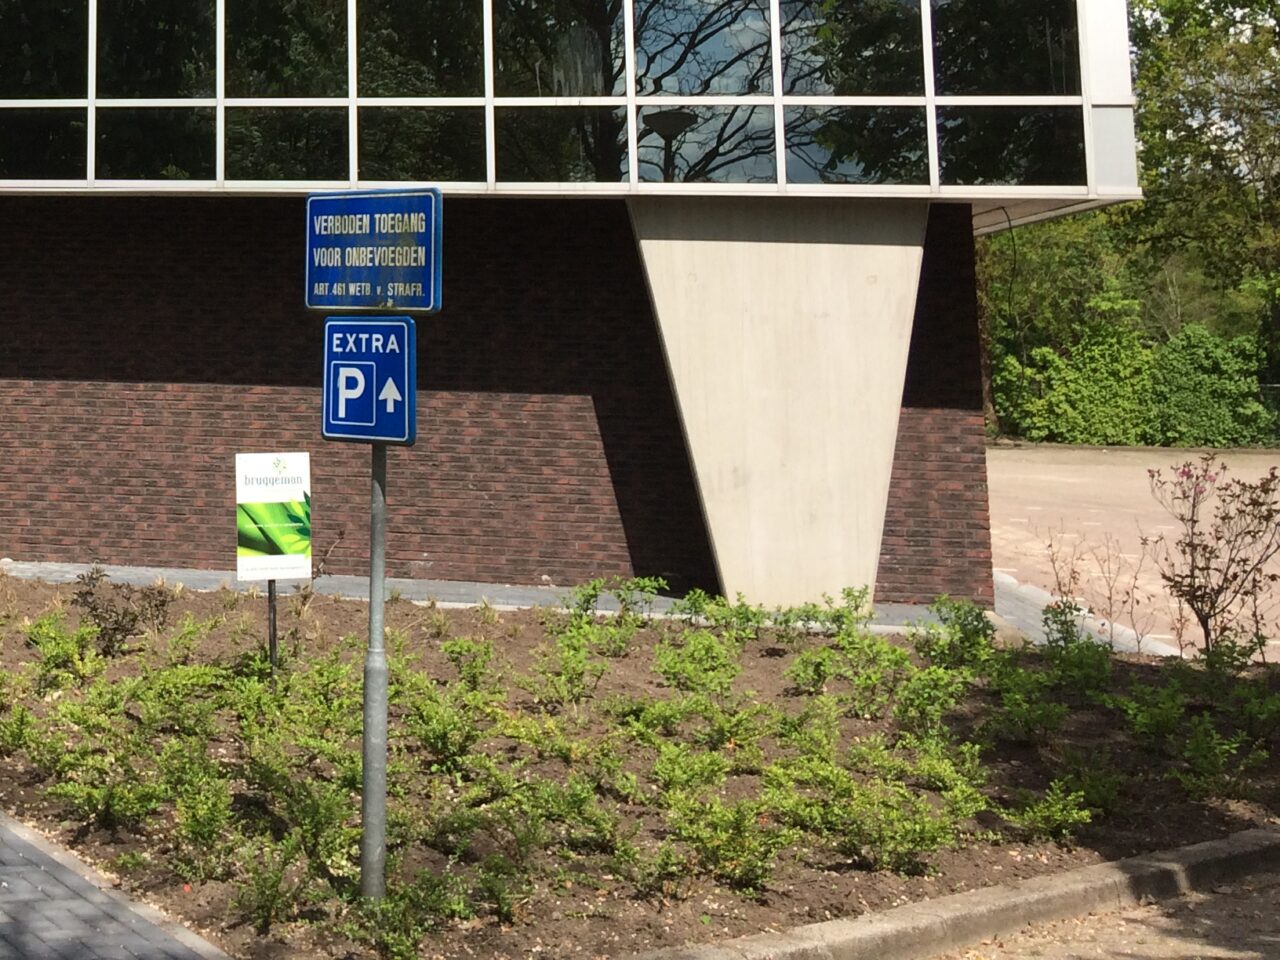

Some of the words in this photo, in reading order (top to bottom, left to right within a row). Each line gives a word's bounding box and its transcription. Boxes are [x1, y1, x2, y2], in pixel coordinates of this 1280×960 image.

[313, 214, 370, 235] VERBODEN
[374, 212, 426, 234] TOEGANG
[313, 247, 341, 267] VOOR
[345, 246, 426, 267] ONBEVOEGDEN
[387, 282, 426, 297] STRAFR.
[332, 333, 401, 354] EXTRA
[338, 367, 366, 418] P
[244, 474, 303, 487] bruggeman
